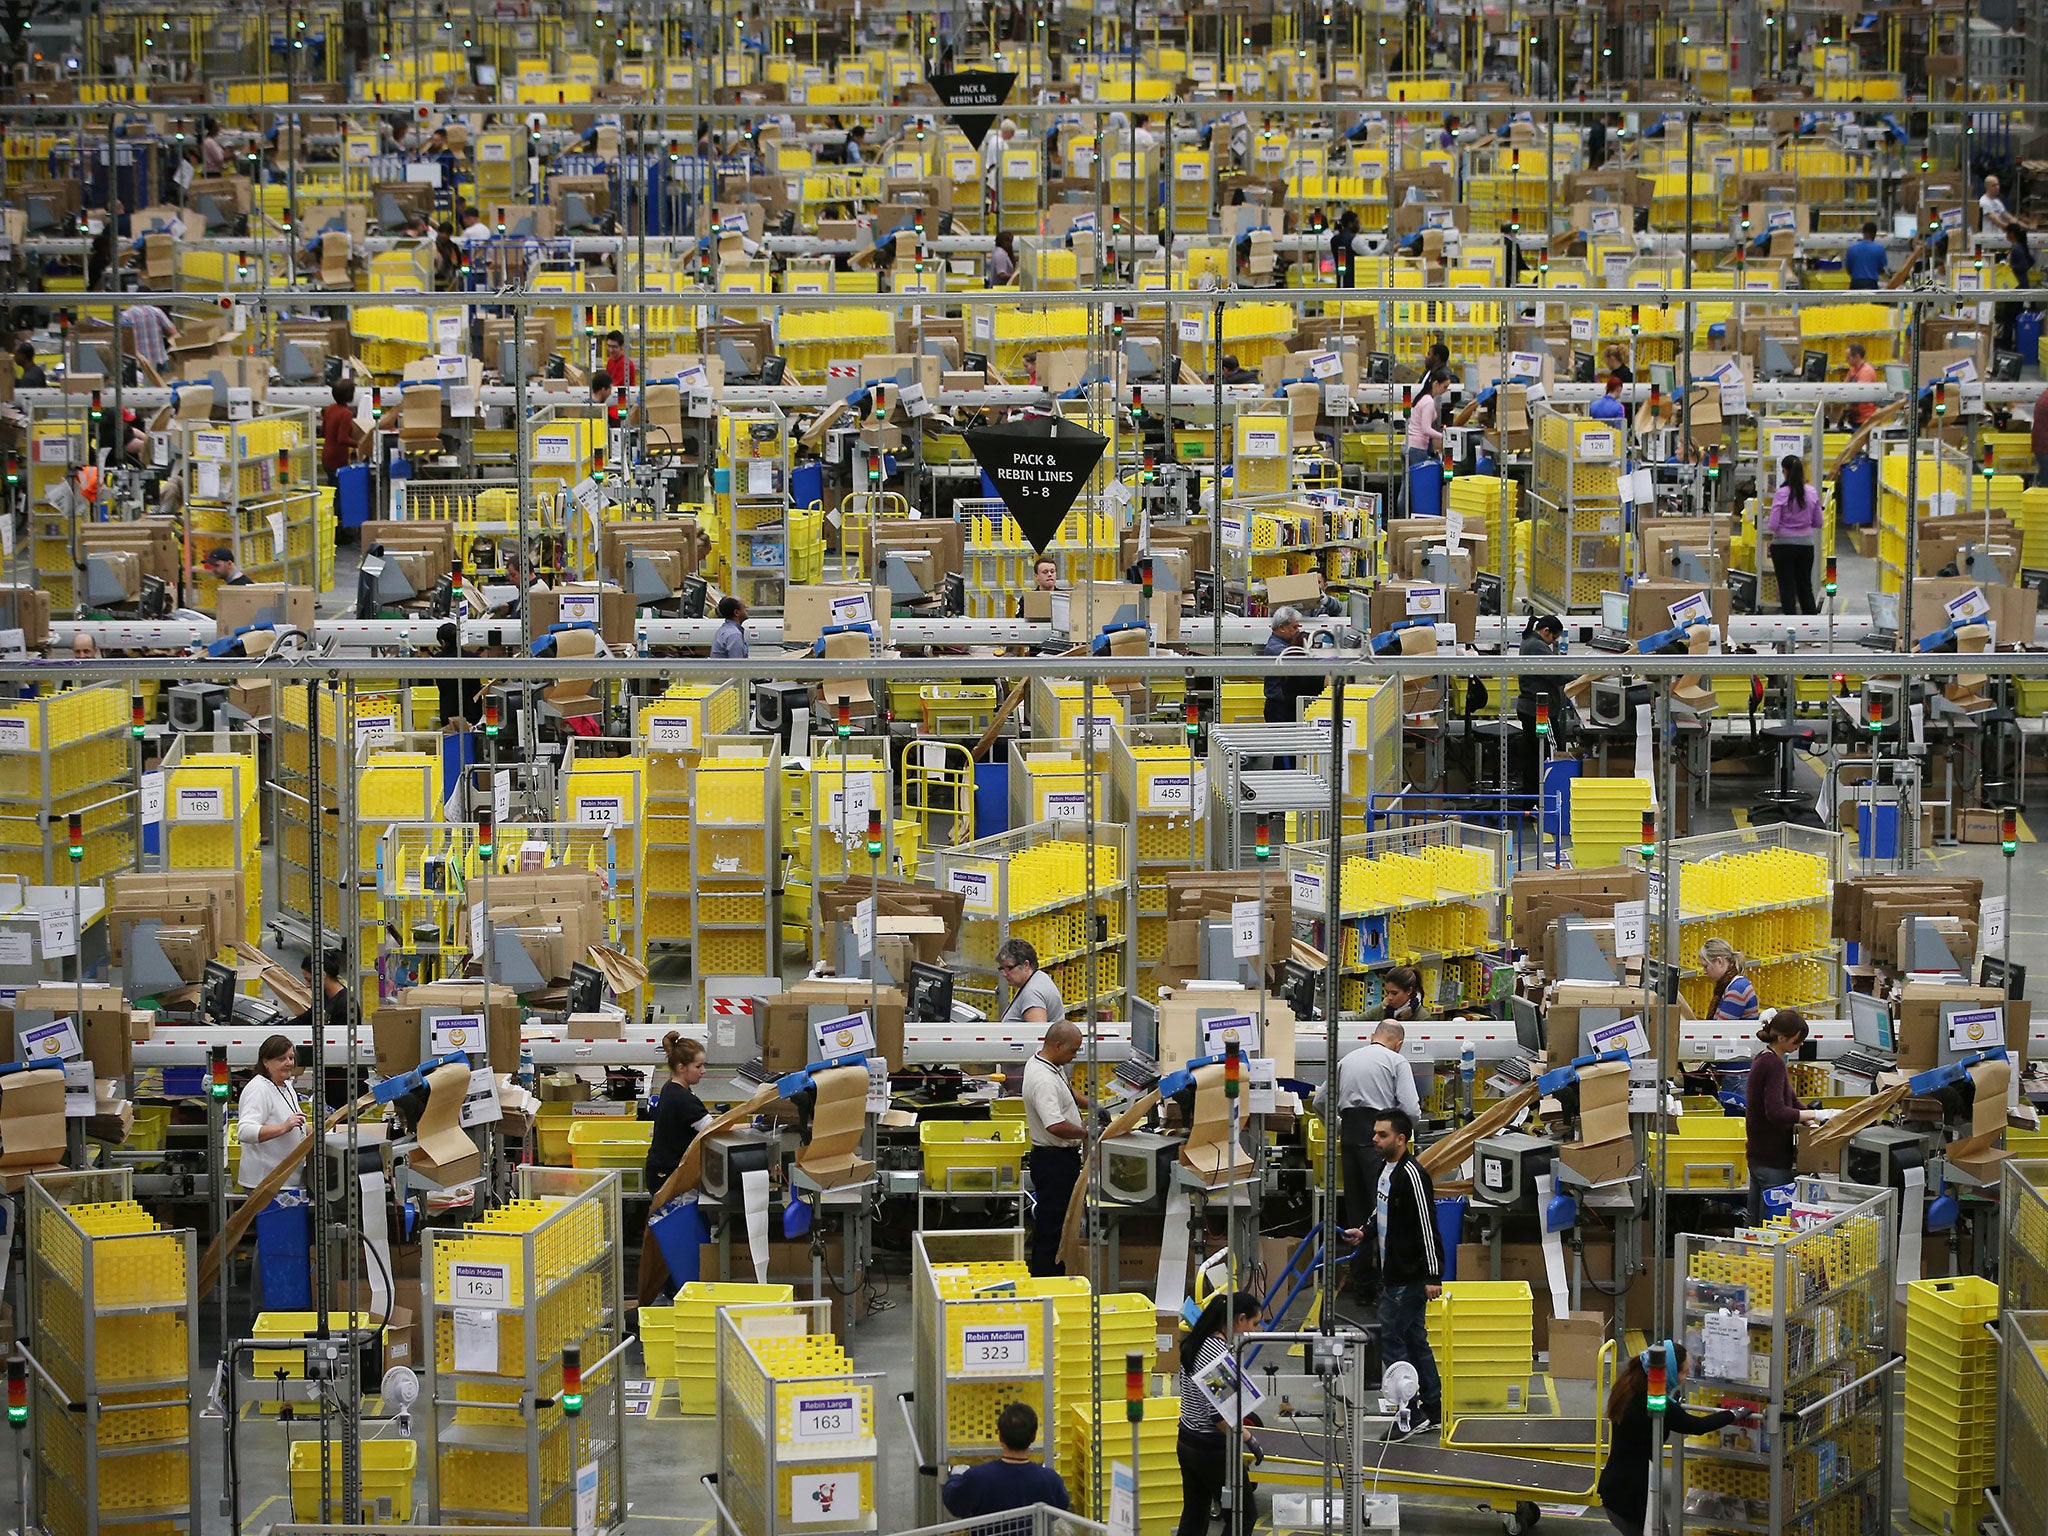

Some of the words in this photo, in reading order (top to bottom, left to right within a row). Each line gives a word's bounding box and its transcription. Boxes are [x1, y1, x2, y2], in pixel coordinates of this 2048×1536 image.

[959, 85, 979, 94] PACK
[980, 85, 986, 93] &
[949, 95, 975, 105] REBIN
[976, 94, 997, 104] LINES
[546, 446, 561, 454] 317
[1255, 441, 1269, 449] 221
[1013, 453, 1045, 466] PACK
[1046, 453, 1057, 466] &
[997, 468, 1035, 482] REBIN
[1037, 469, 1074, 483] LINES
[1022, 486, 1030, 497] 5
[1042, 487, 1051, 498] 8
[358, 719, 372, 727] Rebin
[372, 718, 389, 726] Medium
[661, 729, 680, 739] 233
[197, 791, 218, 799] Medium
[1049, 795, 1064, 803] Rebin
[1161, 789, 1182, 798] 455
[149, 800, 158, 809] 10
[190, 801, 210, 812] 169
[853, 800, 863, 808] 14
[589, 809, 611, 820] 112
[1057, 806, 1076, 815] 131
[954, 872, 967, 880] Rebin
[967, 874, 986, 883] Medium
[960, 885, 979, 896] 464
[1299, 889, 1314, 899] 231
[56, 931, 63, 941] 7
[1242, 930, 1253, 941] 13
[1625, 930, 1637, 941] 15
[1990, 926, 1999, 936] 17
[452, 1019, 478, 1027] READINESS
[1209, 1020, 1225, 1029] AREA
[1225, 1017, 1251, 1027] READINESS
[1955, 1015, 1970, 1023] AREA
[1970, 1013, 1996, 1022] READINESS
[821, 1023, 836, 1032] AREA
[836, 1016, 862, 1029] READINESS
[28, 1029, 44, 1041] AREA
[43, 1022, 69, 1036] READINESS
[1596, 1031, 1612, 1042] AREA
[1611, 1020, 1636, 1035] READINESS
[458, 1267, 476, 1277] Rebin
[477, 1268, 502, 1279] Medium
[967, 1332, 990, 1341] Rebin
[991, 1331, 1023, 1341] Medium
[981, 1346, 1009, 1360] 323
[805, 1400, 825, 1409] Rebin
[826, 1400, 848, 1411] Large
[812, 1416, 840, 1429] 163
